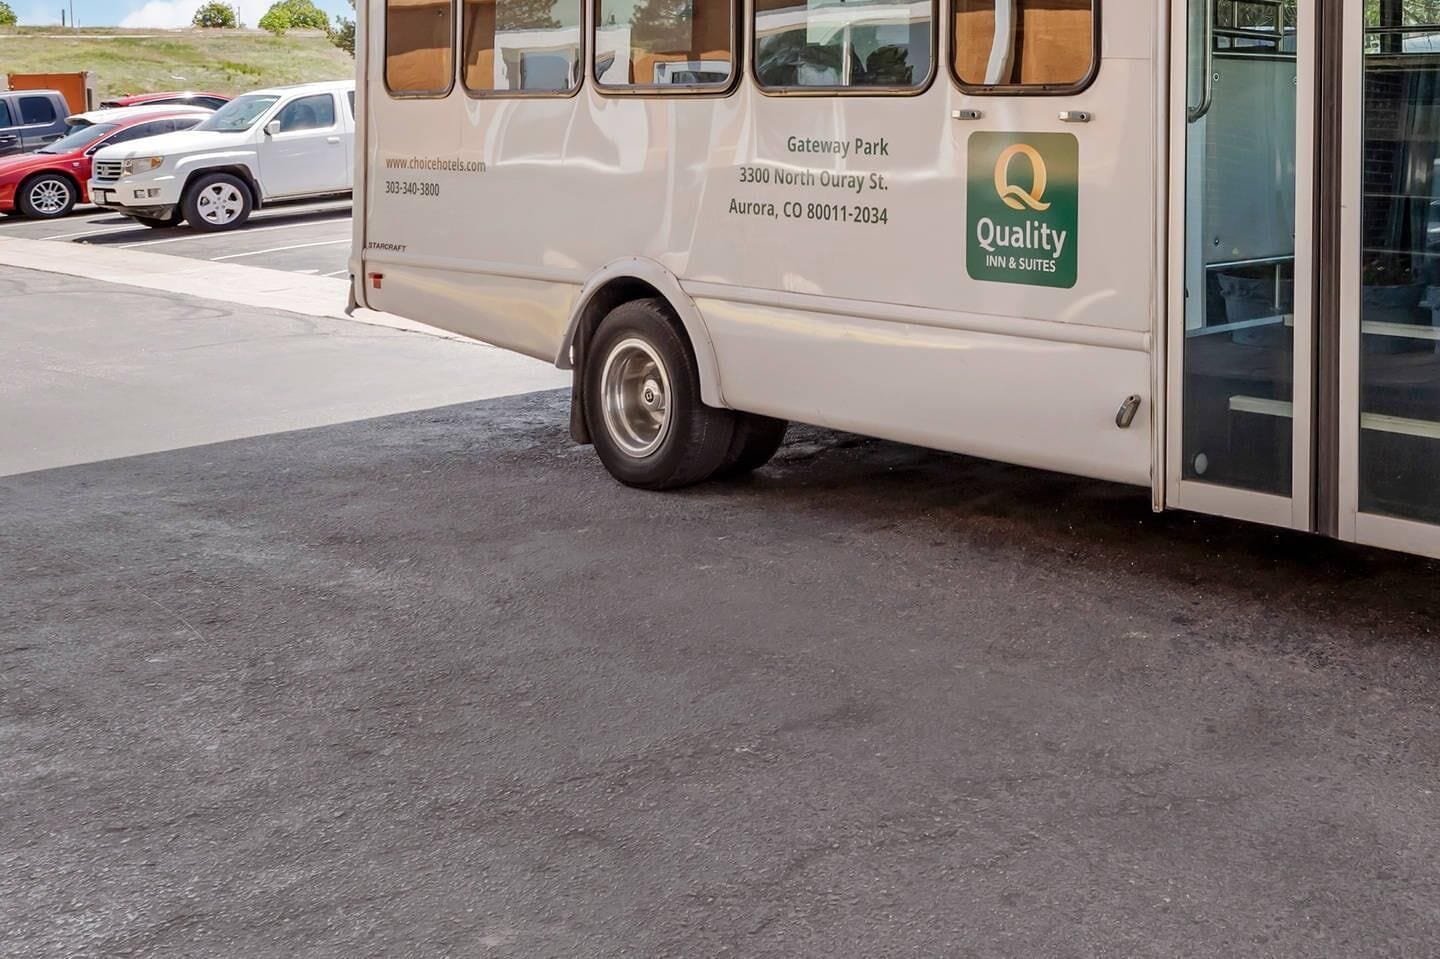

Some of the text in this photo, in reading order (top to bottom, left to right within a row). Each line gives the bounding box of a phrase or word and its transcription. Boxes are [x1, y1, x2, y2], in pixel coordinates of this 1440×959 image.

[787, 136, 889, 159] Gateway Park
[385, 157, 487, 172] www.choicehotels.com
[385, 181, 440, 196] 303-340-3800
[739, 167, 889, 194] 3300 North Ouray St.
[994, 143, 1051, 211] Q
[728, 198, 889, 225] Aurora, CO 80011-2034
[368, 242, 407, 252] STARCRAFT
[976, 217, 1067, 258] Quality
[986, 255, 1057, 272] INN & SUITES
